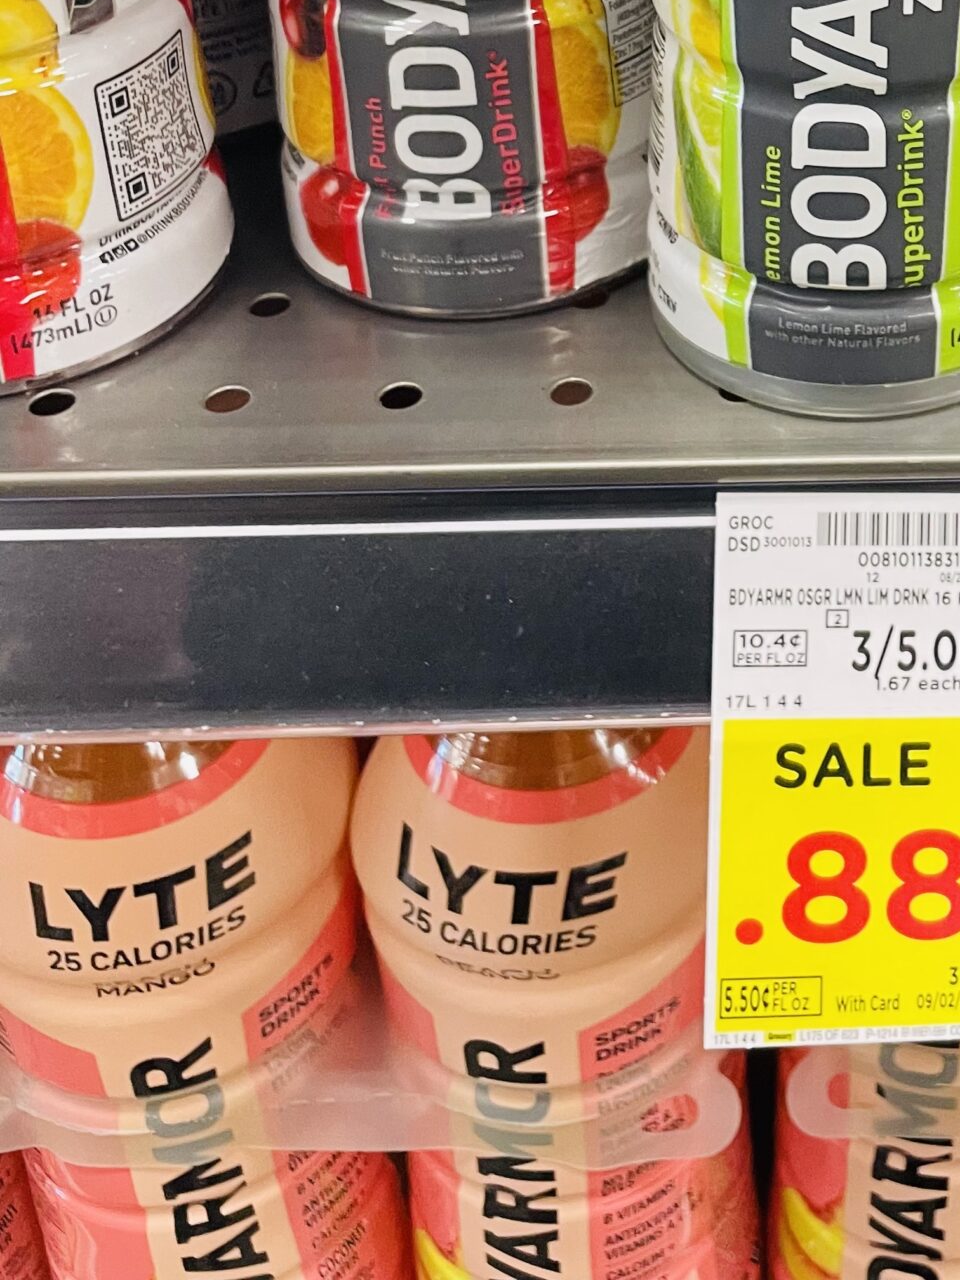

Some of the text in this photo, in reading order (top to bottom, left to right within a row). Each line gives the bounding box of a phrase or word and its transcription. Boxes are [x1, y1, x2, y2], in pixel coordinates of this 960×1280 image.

[364, 96, 387, 169] Punch
[760, 144, 783, 283] emon Lime
[896, 109, 932, 288] uperDrink®
[60, 283, 114, 317] FL OZ
[10, 313, 92, 354] (473mL)
[777, 317, 907, 336] Lemon Lime Flavored
[827, 335, 873, 349] Natural
[876, 333, 920, 349] Flavors
[728, 516, 774, 531] GROC
[728, 536, 812, 552] DSD 3001013
[866, 572, 880, 583] 12
[728, 588, 793, 606] BDYARMR
[835, 588, 863, 606] LMN
[867, 588, 889, 606] LIM
[893, 588, 929, 606] DRNK
[935, 591, 951, 606] 16
[835, 614, 842, 626] 2
[739, 633, 801, 649] 10.4¢
[737, 652, 806, 665] PER FL OZ
[876, 677, 911, 692] 1.67
[726, 695, 757, 709] 17L
[777, 696, 787, 708] 4
[793, 695, 803, 708] 4
[774, 742, 932, 789] SALE
[28, 827, 257, 943] LYTE
[396, 821, 628, 925] LYTE
[48, 905, 247, 972] 25 CALORIES
[401, 898, 598, 955] 25 CALORIES
[258, 952, 333, 1022] SPORTS
[773, 981, 798, 996] PER
[836, 995, 867, 1013] With
[870, 994, 900, 1012] Card
[261, 987, 320, 1038] DRINK
[594, 996, 682, 1047] SPORTS
[772, 997, 810, 1012] FL OZ
[595, 1027, 663, 1062] DRINK
[130, 1036, 275, 1280] ARMOR
[463, 1038, 561, 1280] ARMOR
